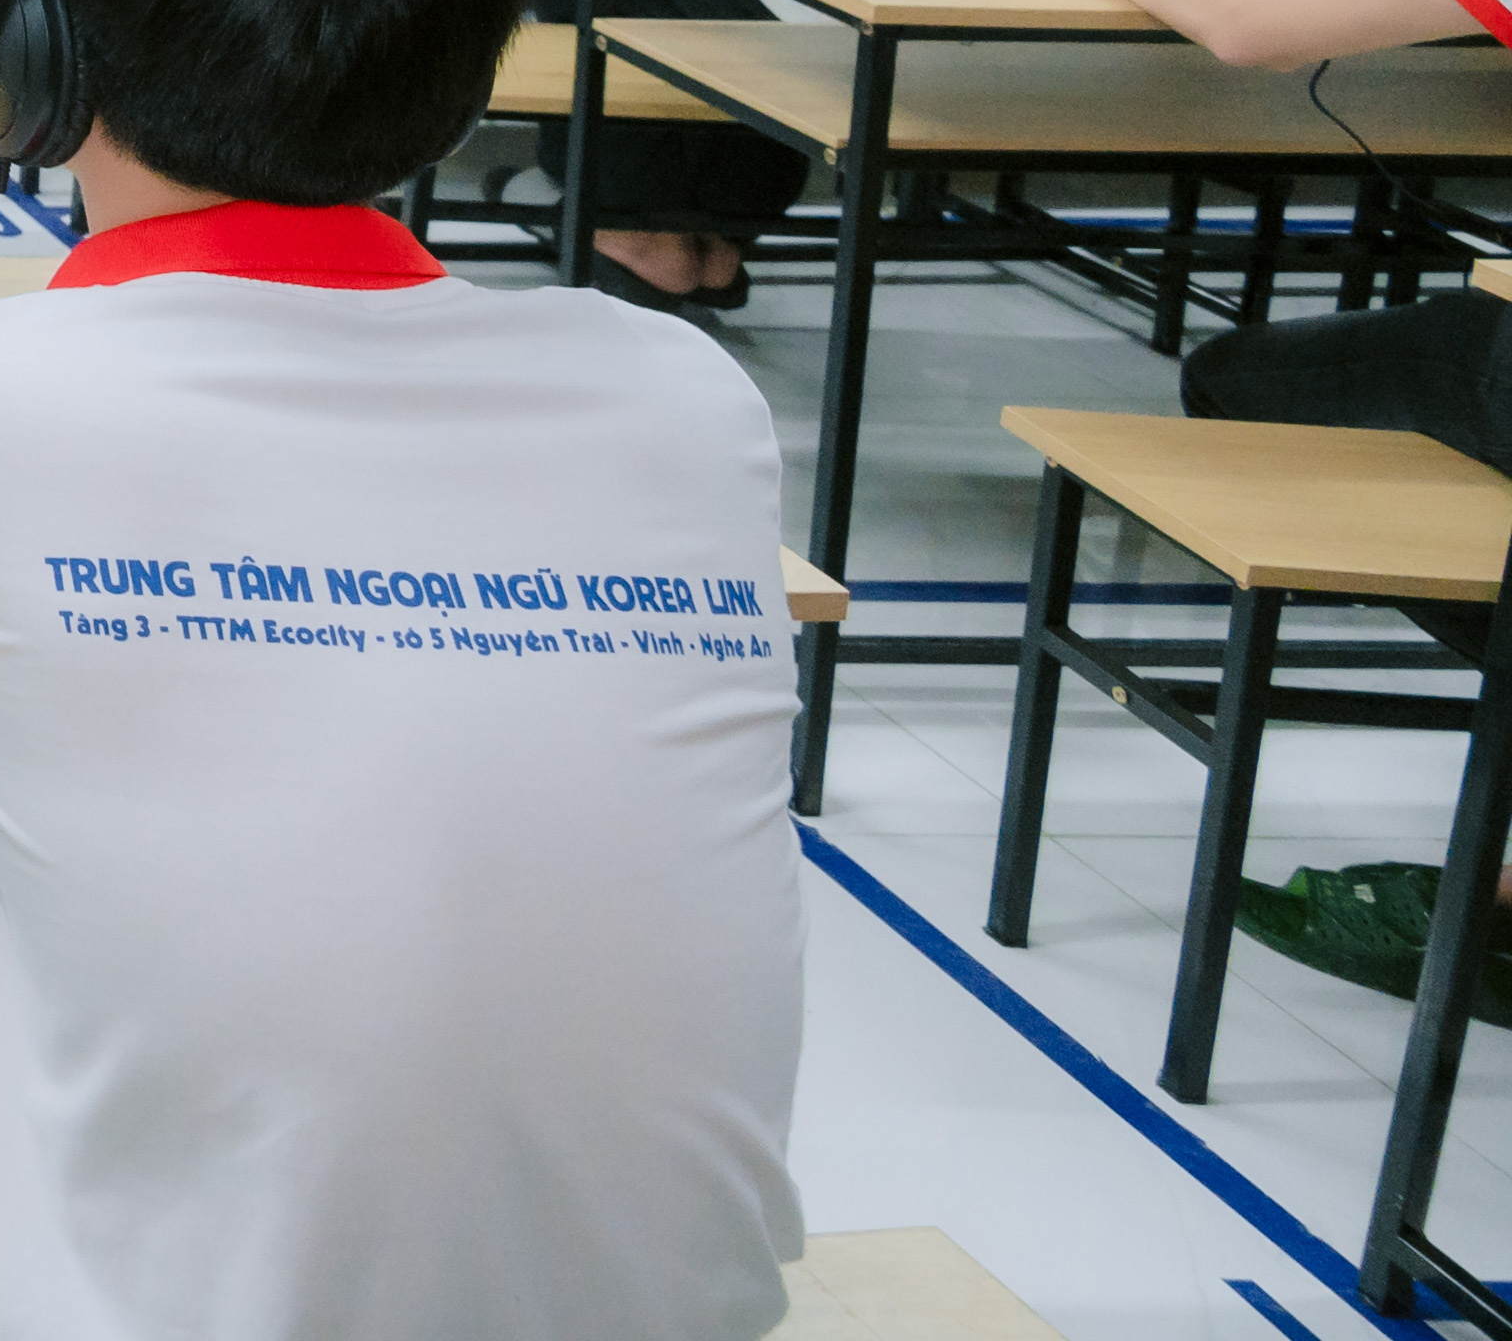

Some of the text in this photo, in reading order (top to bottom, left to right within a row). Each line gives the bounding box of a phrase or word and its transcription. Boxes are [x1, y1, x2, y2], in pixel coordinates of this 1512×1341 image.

[44, 555, 764, 617] TRUNG TÂM NGOẠI NGỮ KOREA LINK
[135, 614, 151, 638] 3
[176, 614, 257, 643] TTTM
[263, 618, 366, 652] Ecocity
[430, 627, 446, 650] 5
[631, 629, 685, 656] Vinh
[751, 634, 772, 658] An
